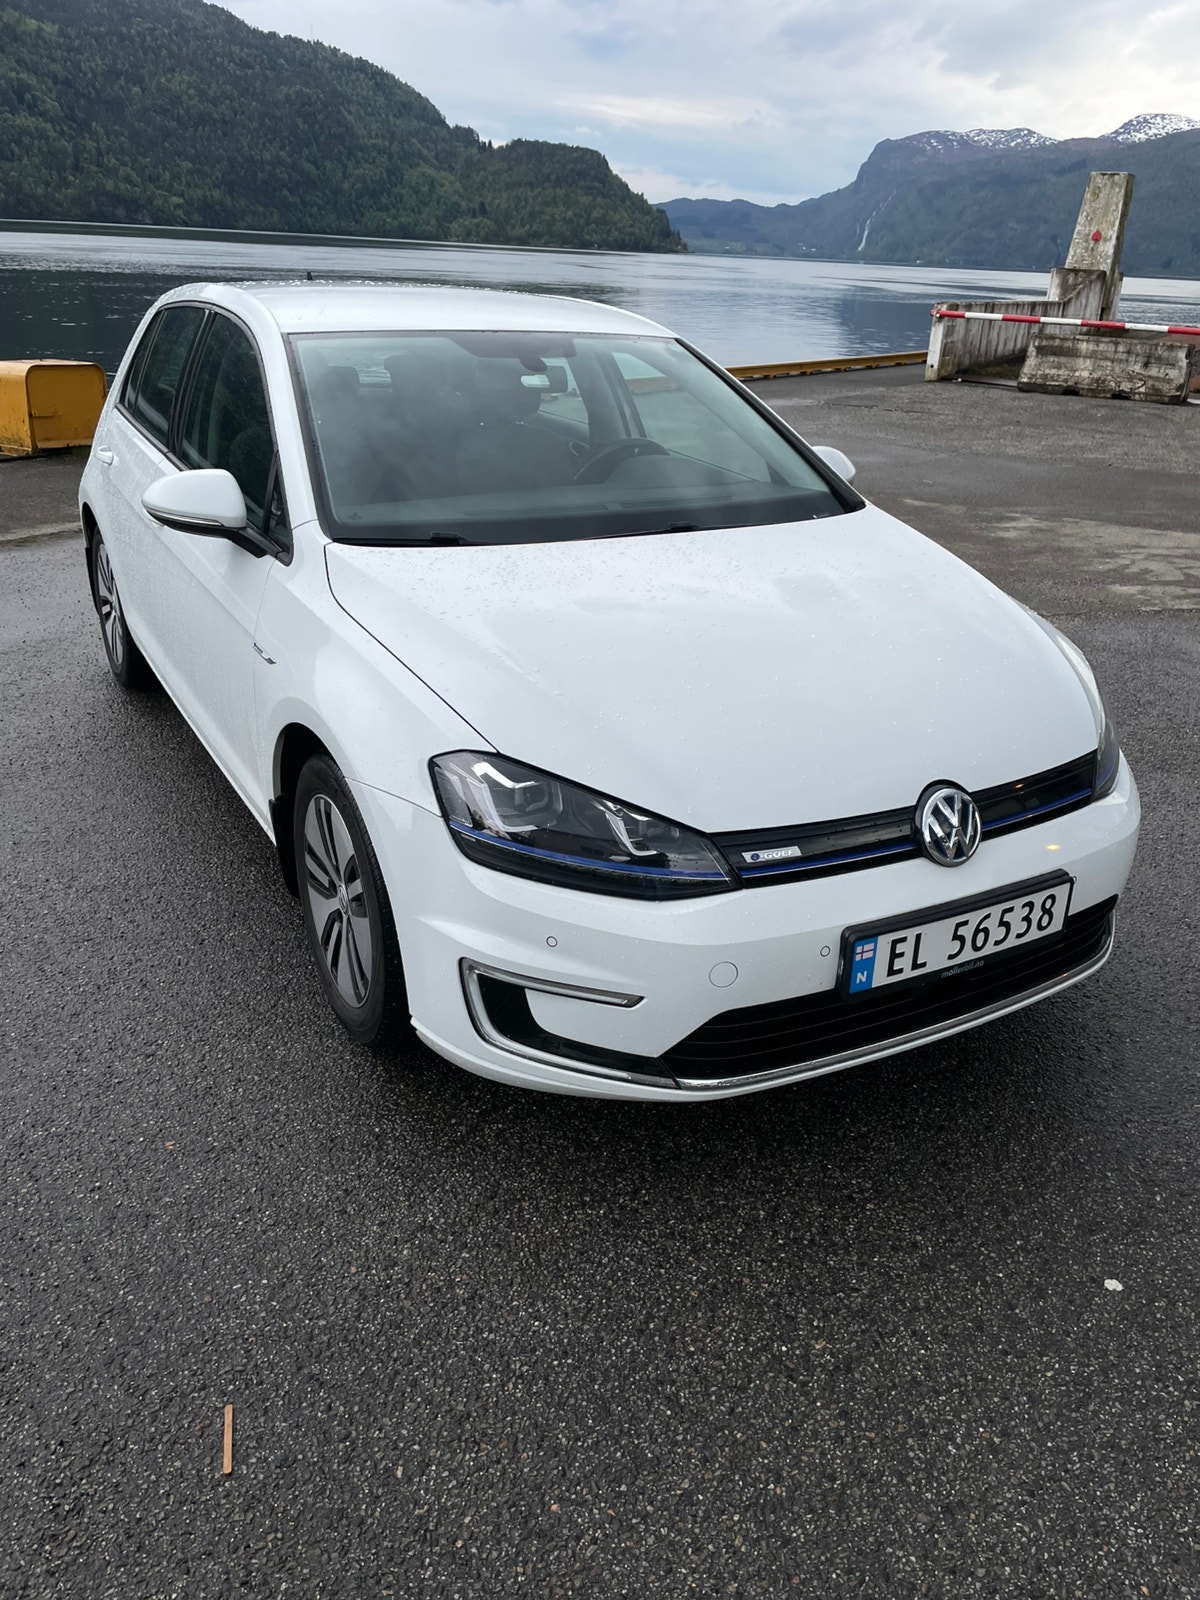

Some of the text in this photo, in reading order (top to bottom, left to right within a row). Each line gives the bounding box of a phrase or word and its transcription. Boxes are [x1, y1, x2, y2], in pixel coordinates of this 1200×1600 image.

[887, 893, 1057, 978] EL 56538
[856, 970, 868, 984] N
